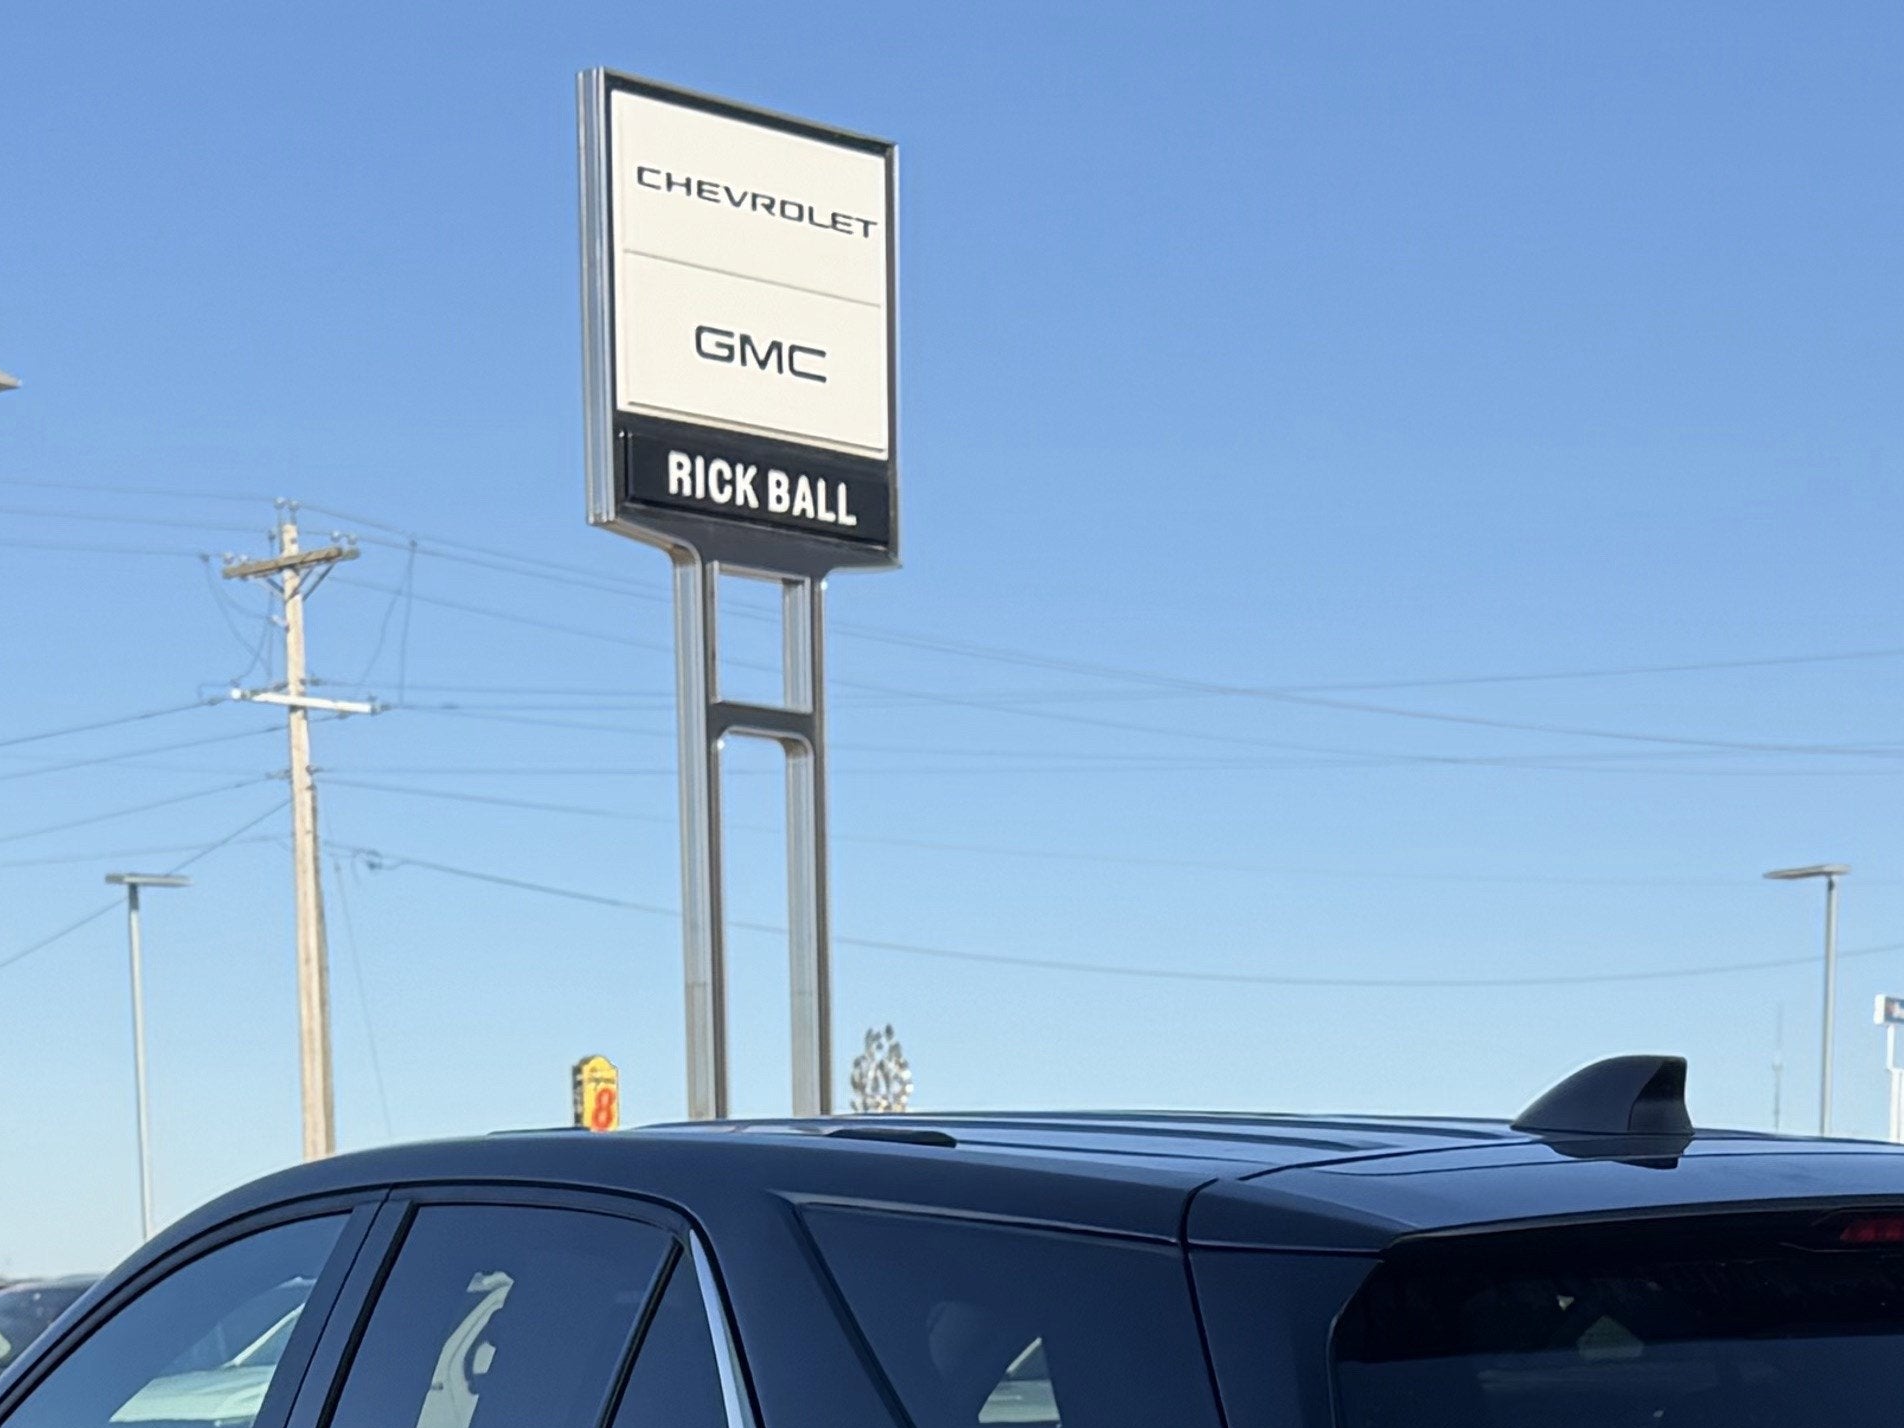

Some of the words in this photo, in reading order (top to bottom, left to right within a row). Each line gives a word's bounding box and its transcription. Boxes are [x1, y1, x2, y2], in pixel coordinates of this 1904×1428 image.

[636, 166, 878, 239] CHEVROLET
[695, 325, 827, 383] GMC
[667, 450, 759, 509] RICK
[767, 469, 858, 527] BALL
